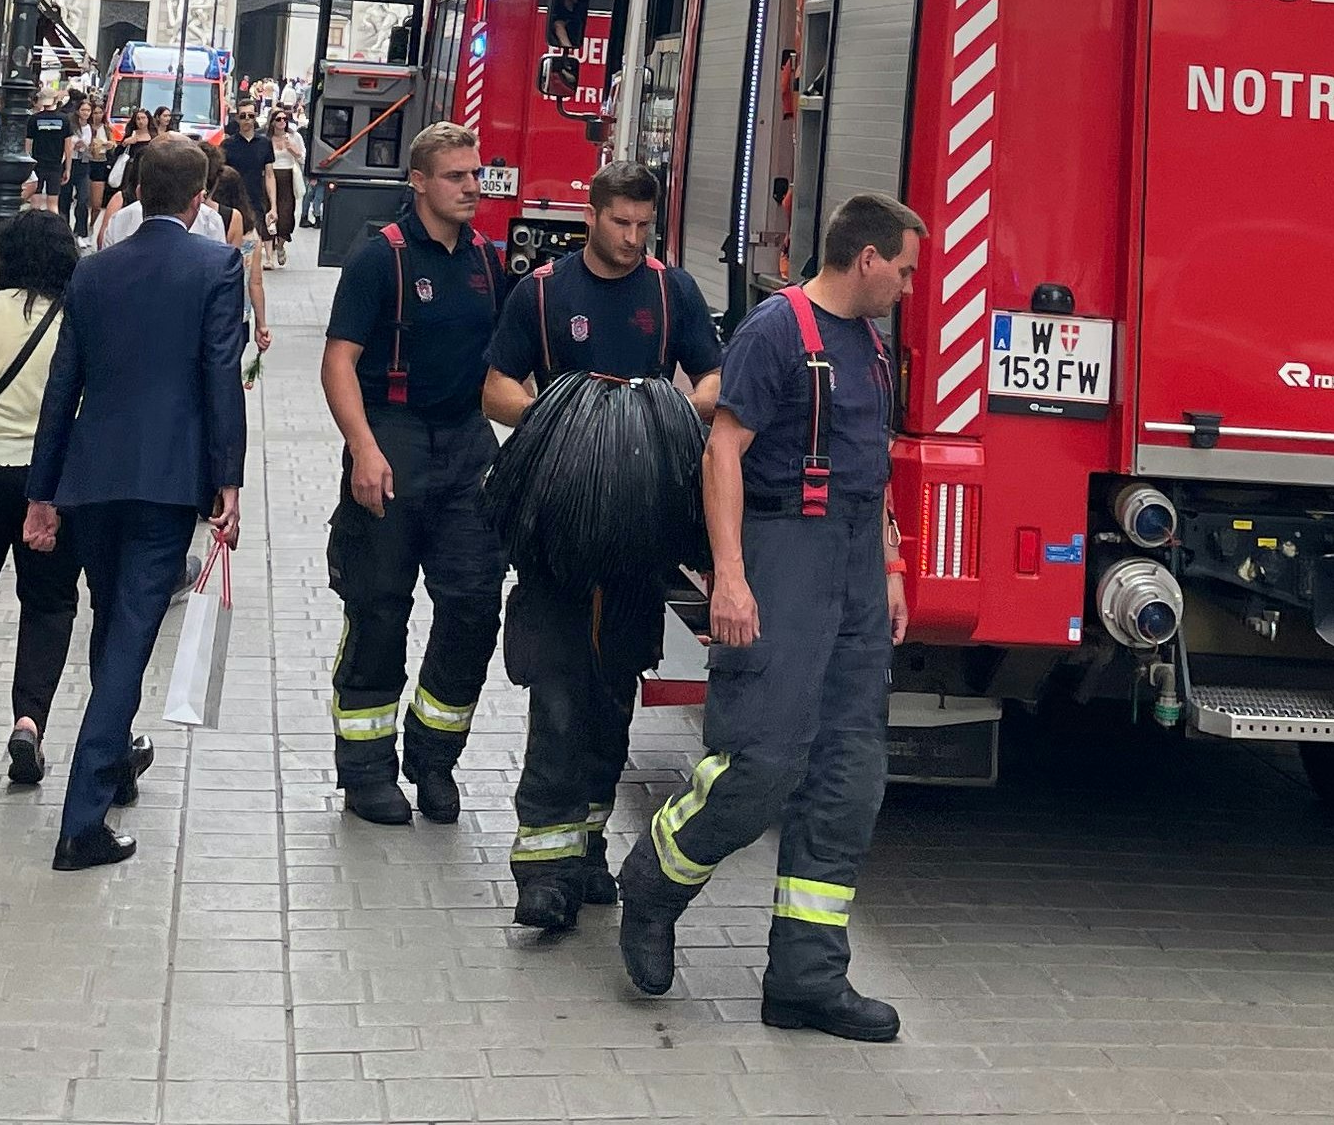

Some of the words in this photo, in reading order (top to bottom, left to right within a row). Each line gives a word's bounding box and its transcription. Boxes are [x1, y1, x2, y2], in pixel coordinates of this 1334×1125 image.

[488, 168, 504, 180] FW
[482, 180, 501, 191] 305
[997, 337, 1007, 349] A
[1031, 321, 1054, 355] W
